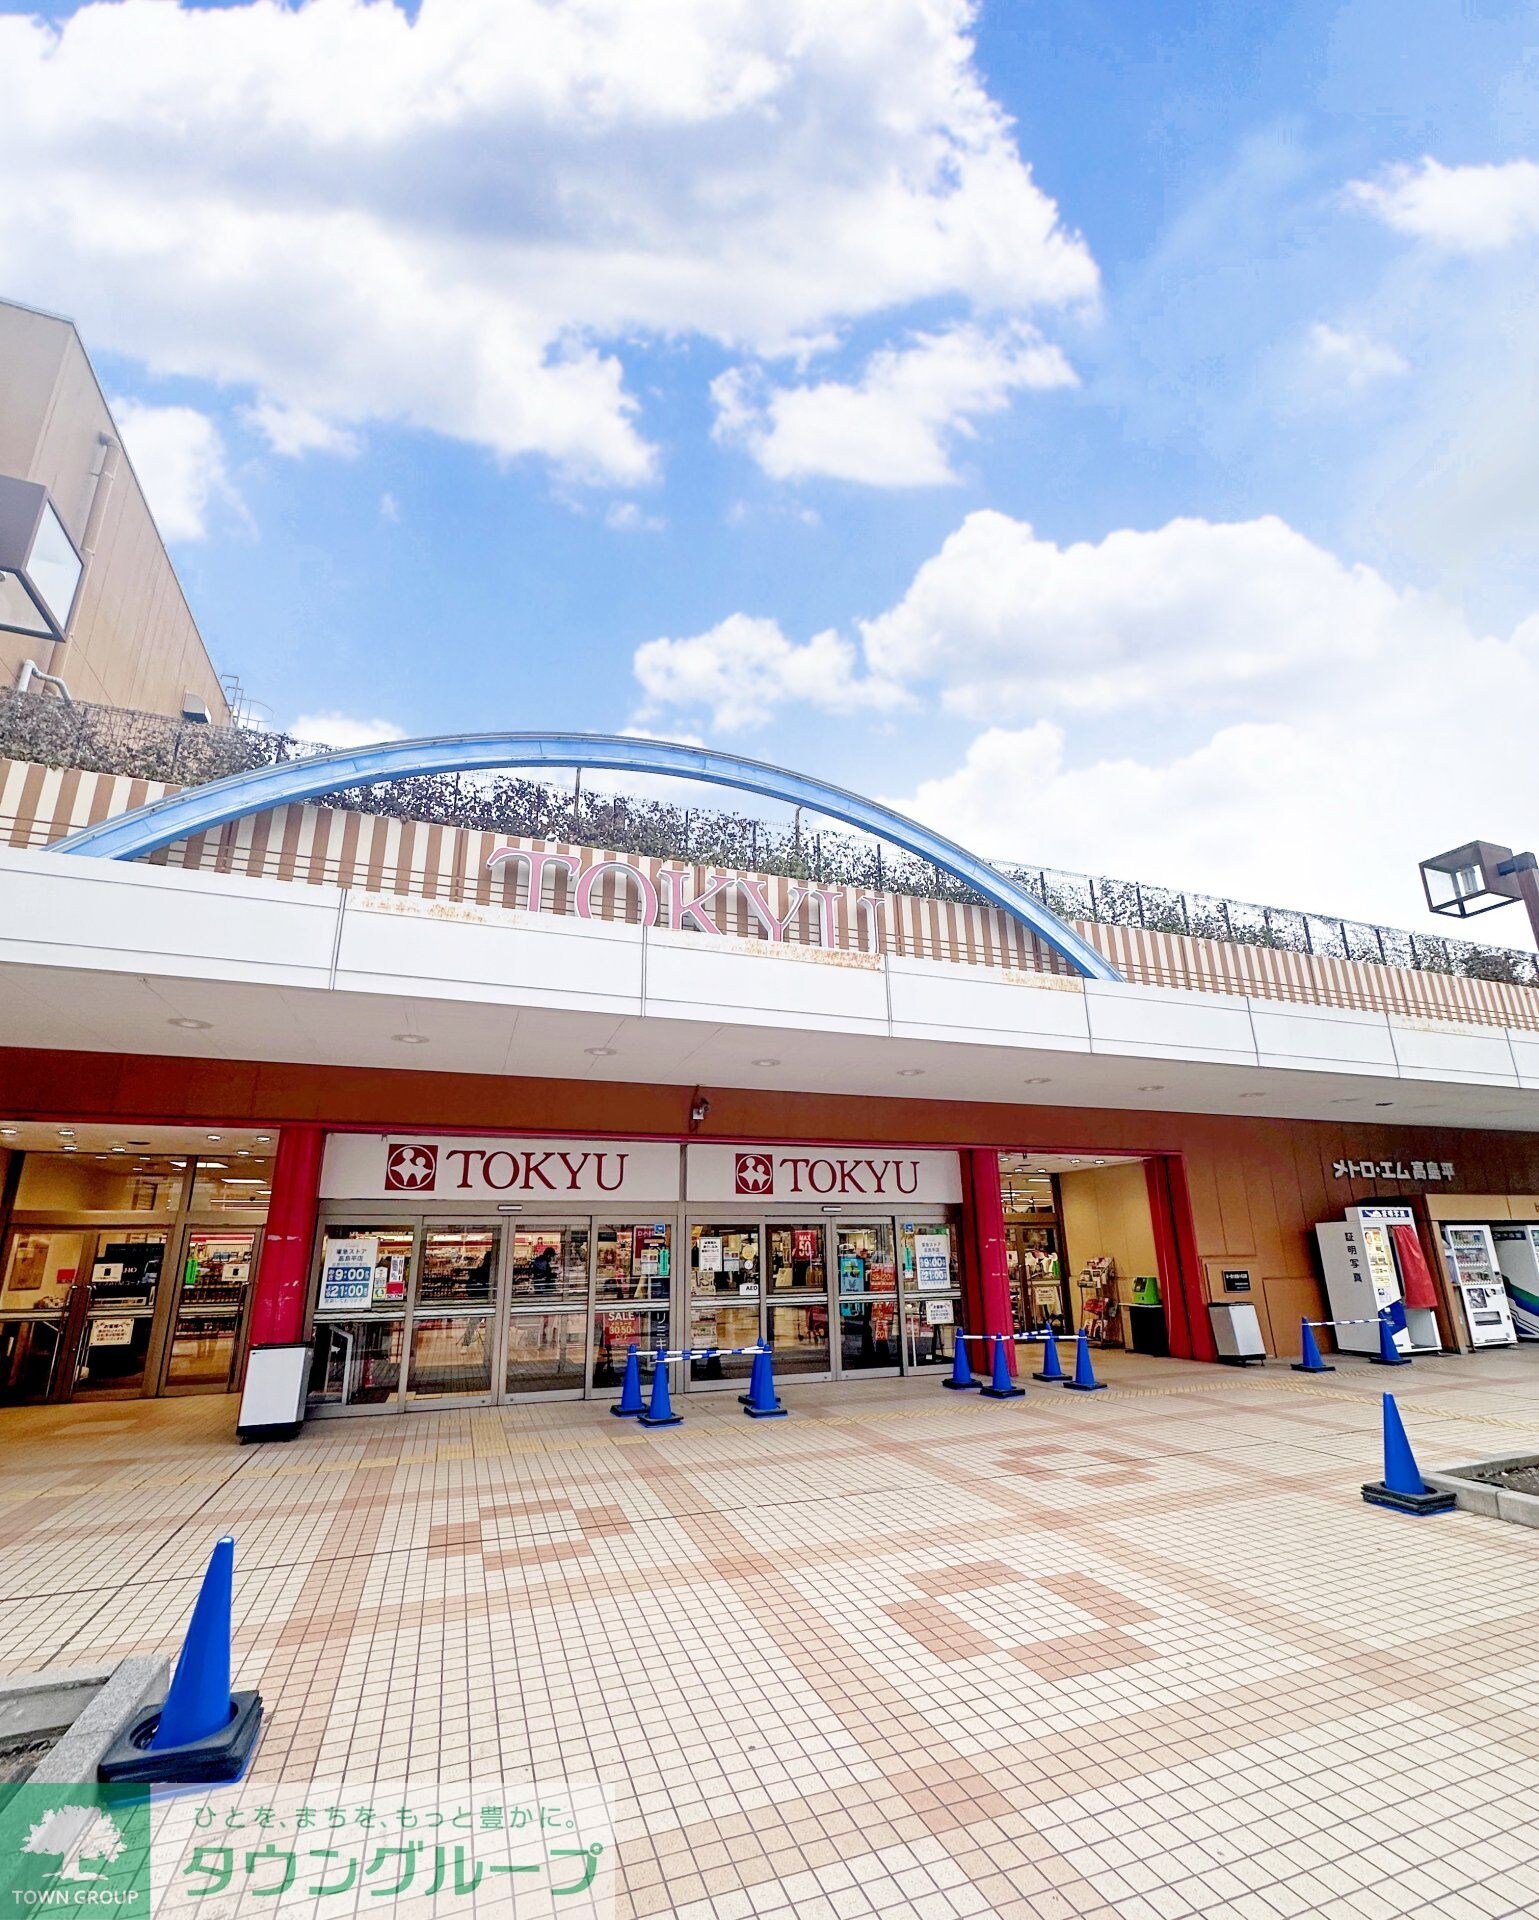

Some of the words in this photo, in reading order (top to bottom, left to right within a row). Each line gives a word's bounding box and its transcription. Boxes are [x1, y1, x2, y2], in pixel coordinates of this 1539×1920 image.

[445, 1149, 629, 1191] TOKYU
[779, 1158, 920, 1194] TOKYU
[1344, 1232, 1362, 1283] 証明写真
[335, 1268, 365, 1281] 9:00
[330, 1285, 364, 1297] 21:00
[608, 1311, 636, 1321] SALE
